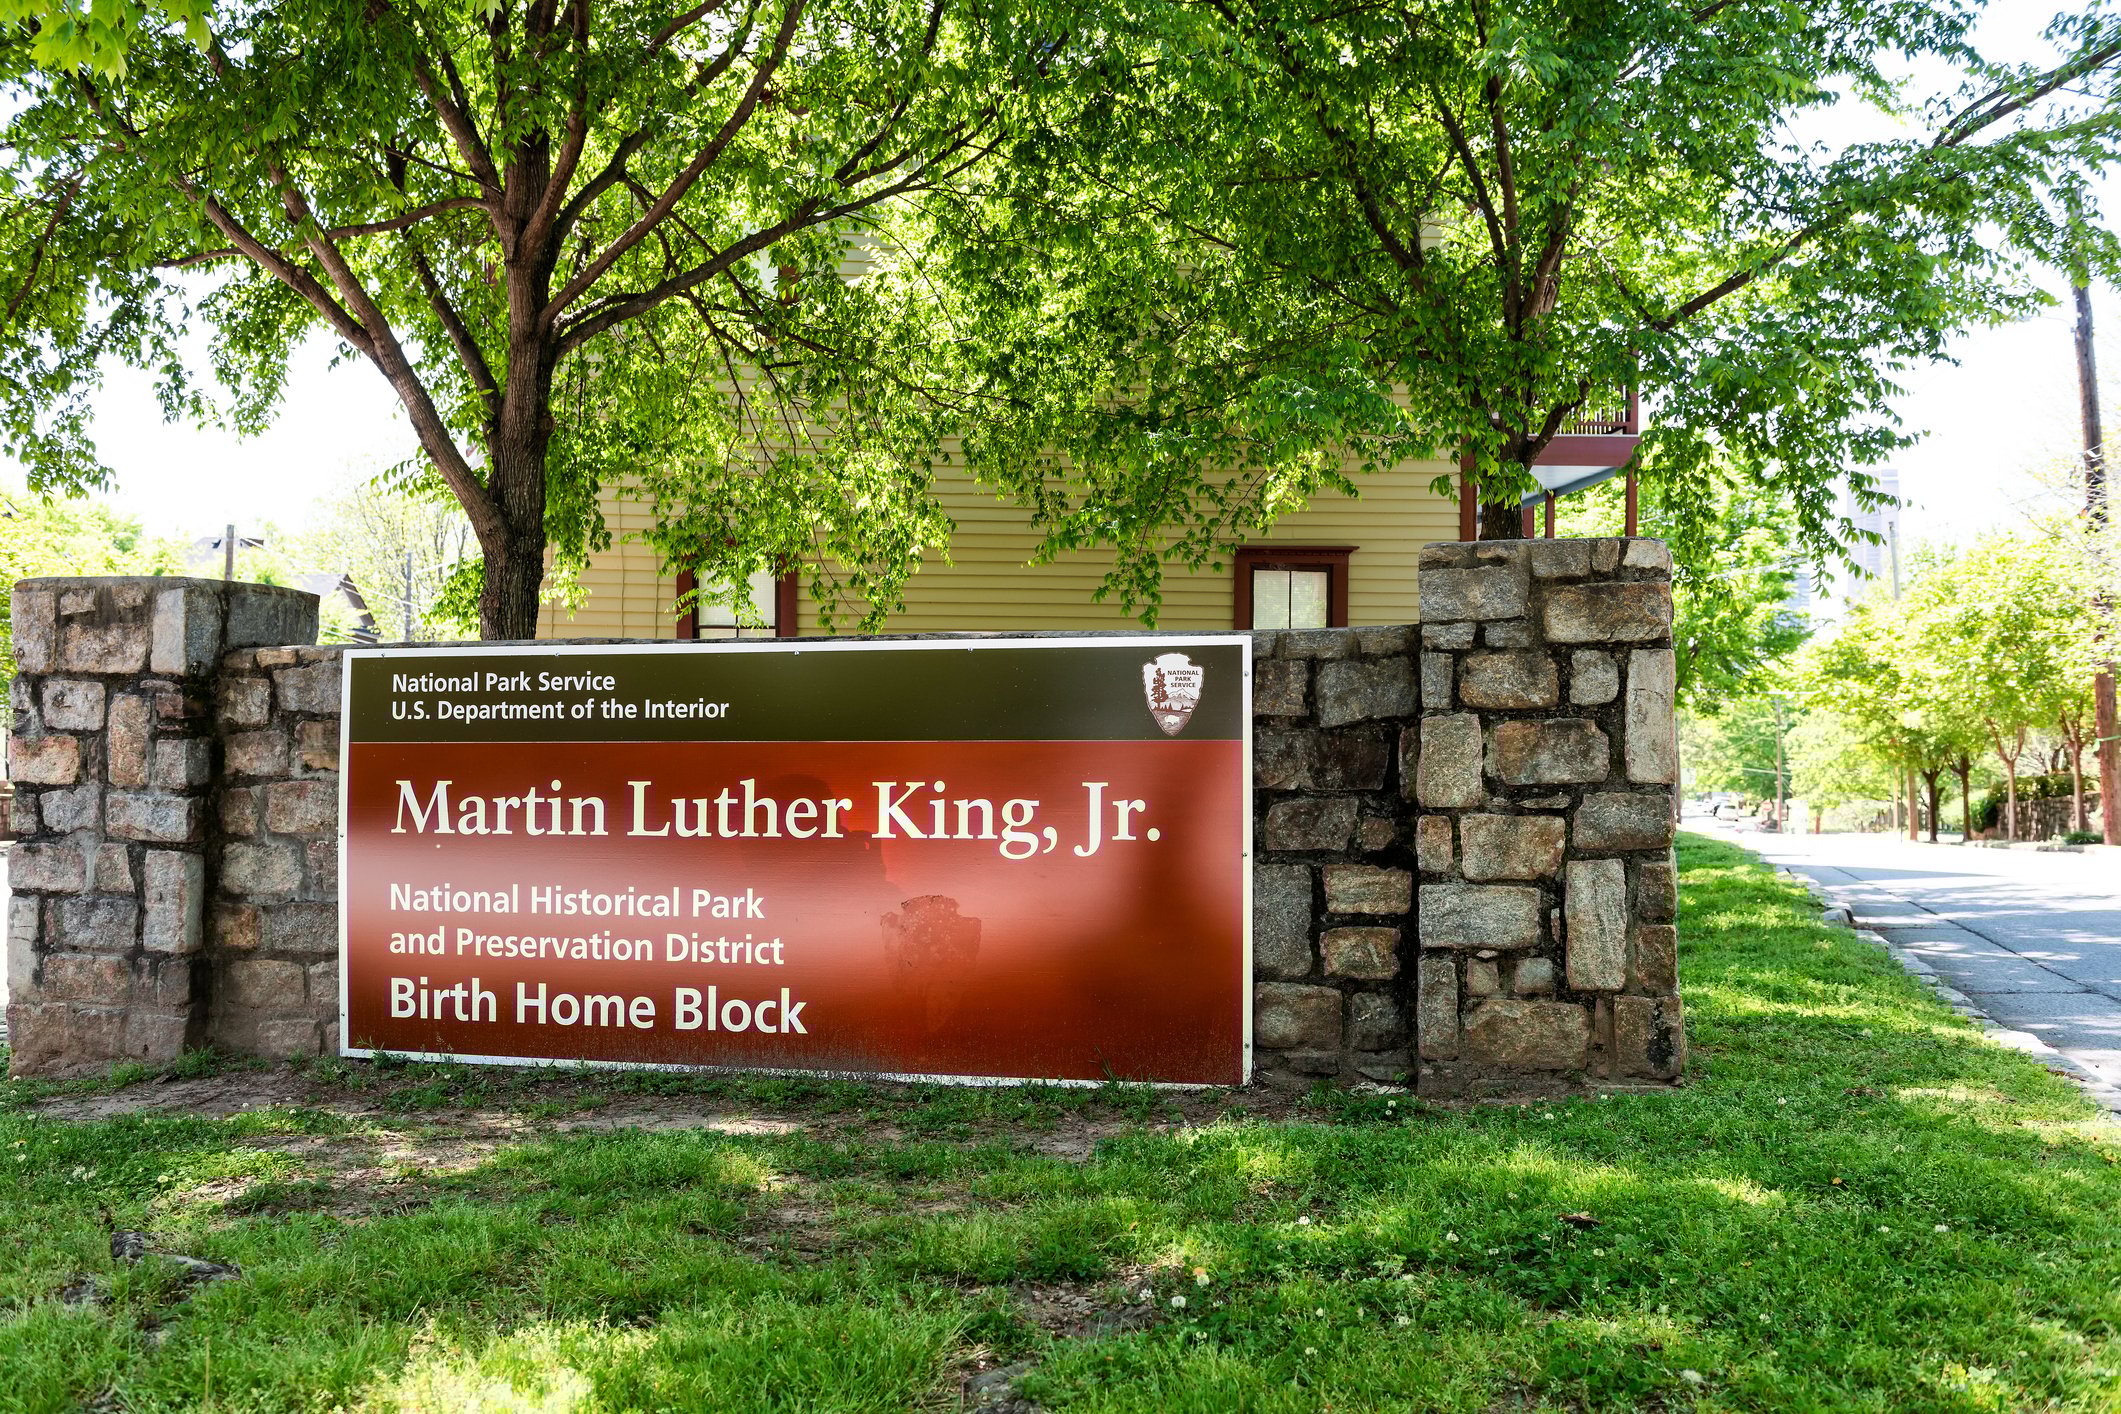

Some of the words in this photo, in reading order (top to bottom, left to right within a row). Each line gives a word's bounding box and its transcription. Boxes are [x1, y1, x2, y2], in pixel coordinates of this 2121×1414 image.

[393, 672, 478, 692] National
[486, 671, 531, 691] Park
[539, 671, 615, 691] Service
[393, 701, 429, 719] U.S.
[438, 701, 564, 724] Department
[571, 698, 594, 718] of
[601, 699, 637, 718] the
[645, 698, 729, 718] Interior
[391, 780, 608, 835] Martin
[627, 779, 852, 838] Luther
[872, 781, 1057, 859] King,
[1074, 782, 1160, 857] Jr.
[391, 883, 518, 913] National
[532, 886, 679, 916] Historical
[693, 888, 765, 918] Park
[390, 926, 444, 954] and
[457, 928, 652, 960] Preservation
[667, 933, 784, 964] District
[391, 977, 496, 1021] Birth
[517, 982, 655, 1028] Home
[676, 986, 807, 1033] Block
